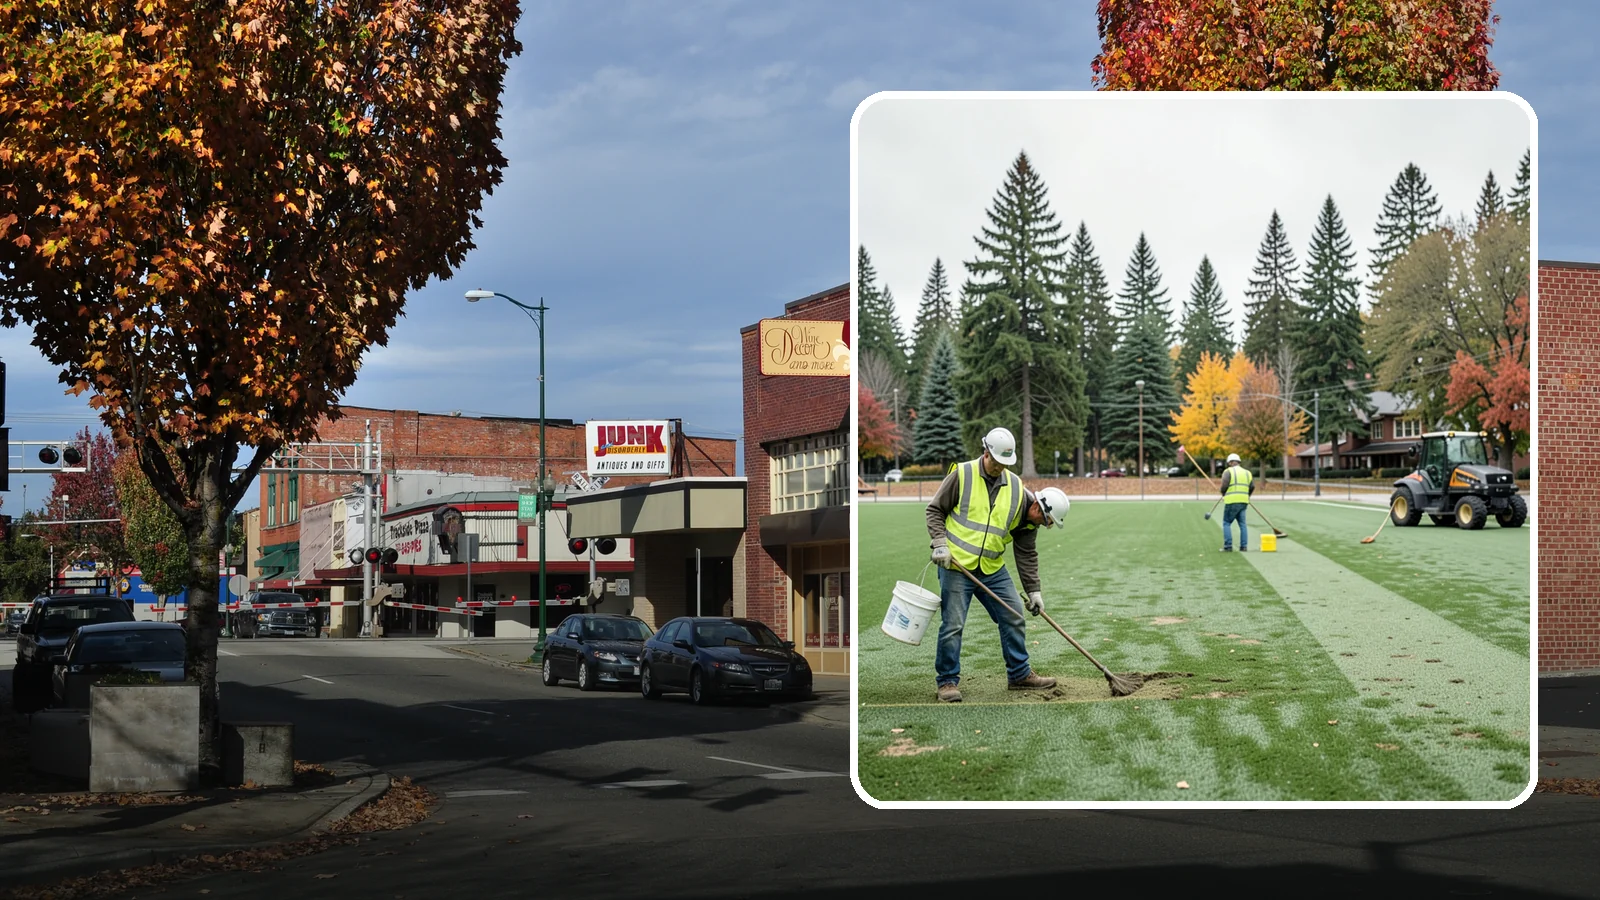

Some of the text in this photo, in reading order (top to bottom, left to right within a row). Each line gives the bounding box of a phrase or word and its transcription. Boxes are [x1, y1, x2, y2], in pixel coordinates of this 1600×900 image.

[765, 328, 831, 365] Decor
[595, 425, 665, 457] JUNK
[607, 446, 646, 454] DISORDERLY
[597, 460, 665, 470] ANTIQUES AND GIFTS
[414, 519, 429, 534] Pizza
